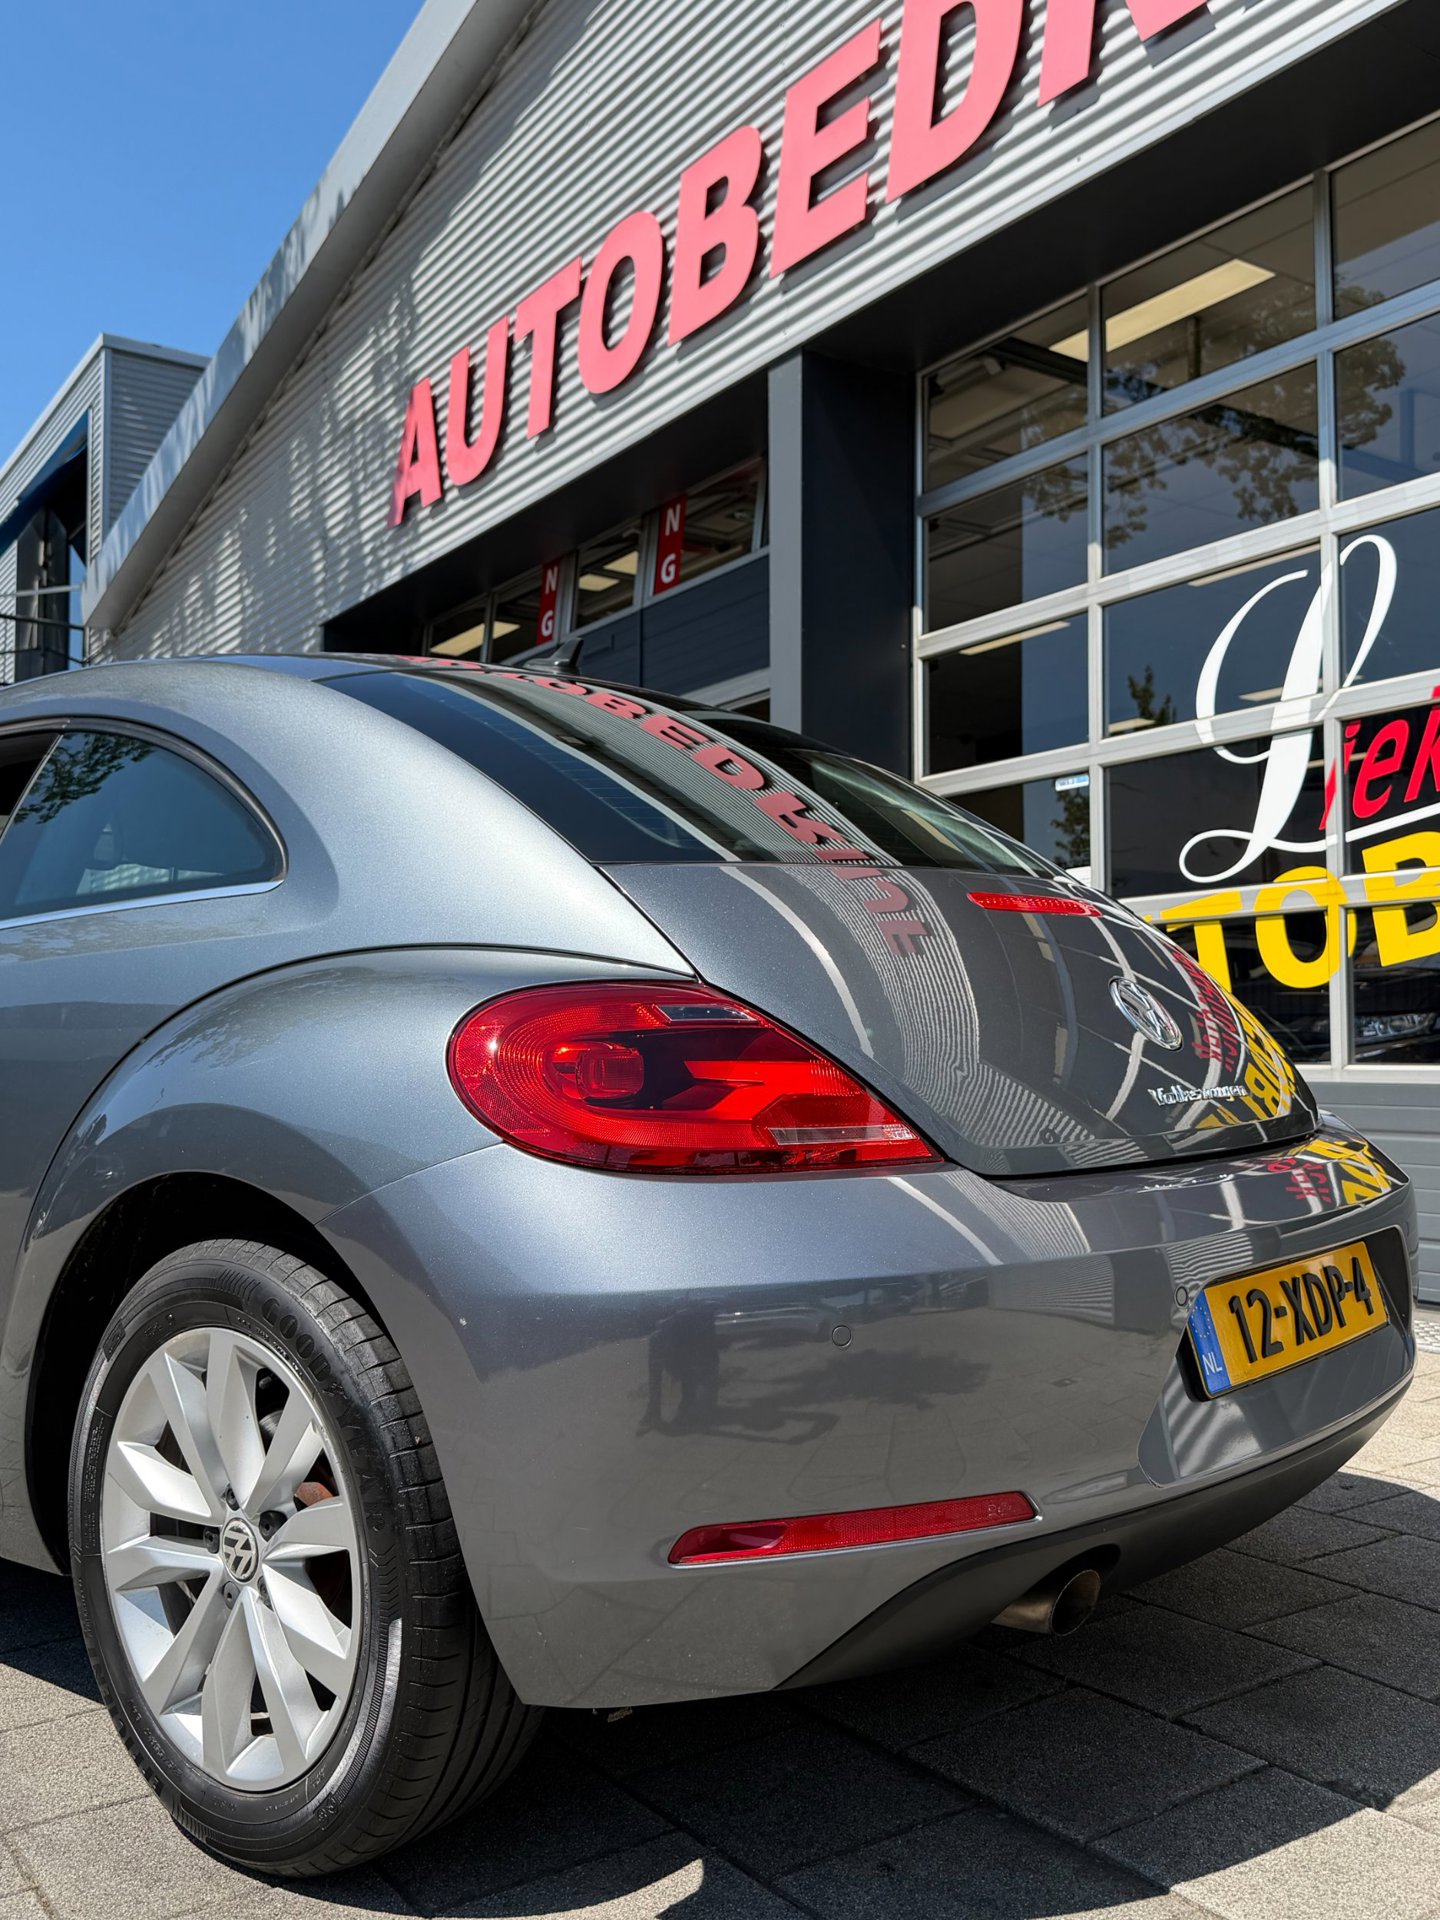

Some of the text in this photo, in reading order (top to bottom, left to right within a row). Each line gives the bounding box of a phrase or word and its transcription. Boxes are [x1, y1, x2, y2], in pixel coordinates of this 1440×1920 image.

[1141, 831, 1440, 993] TOB
[1202, 1352, 1222, 1376] NL
[1228, 1257, 1374, 1364] 12-XDP-4
